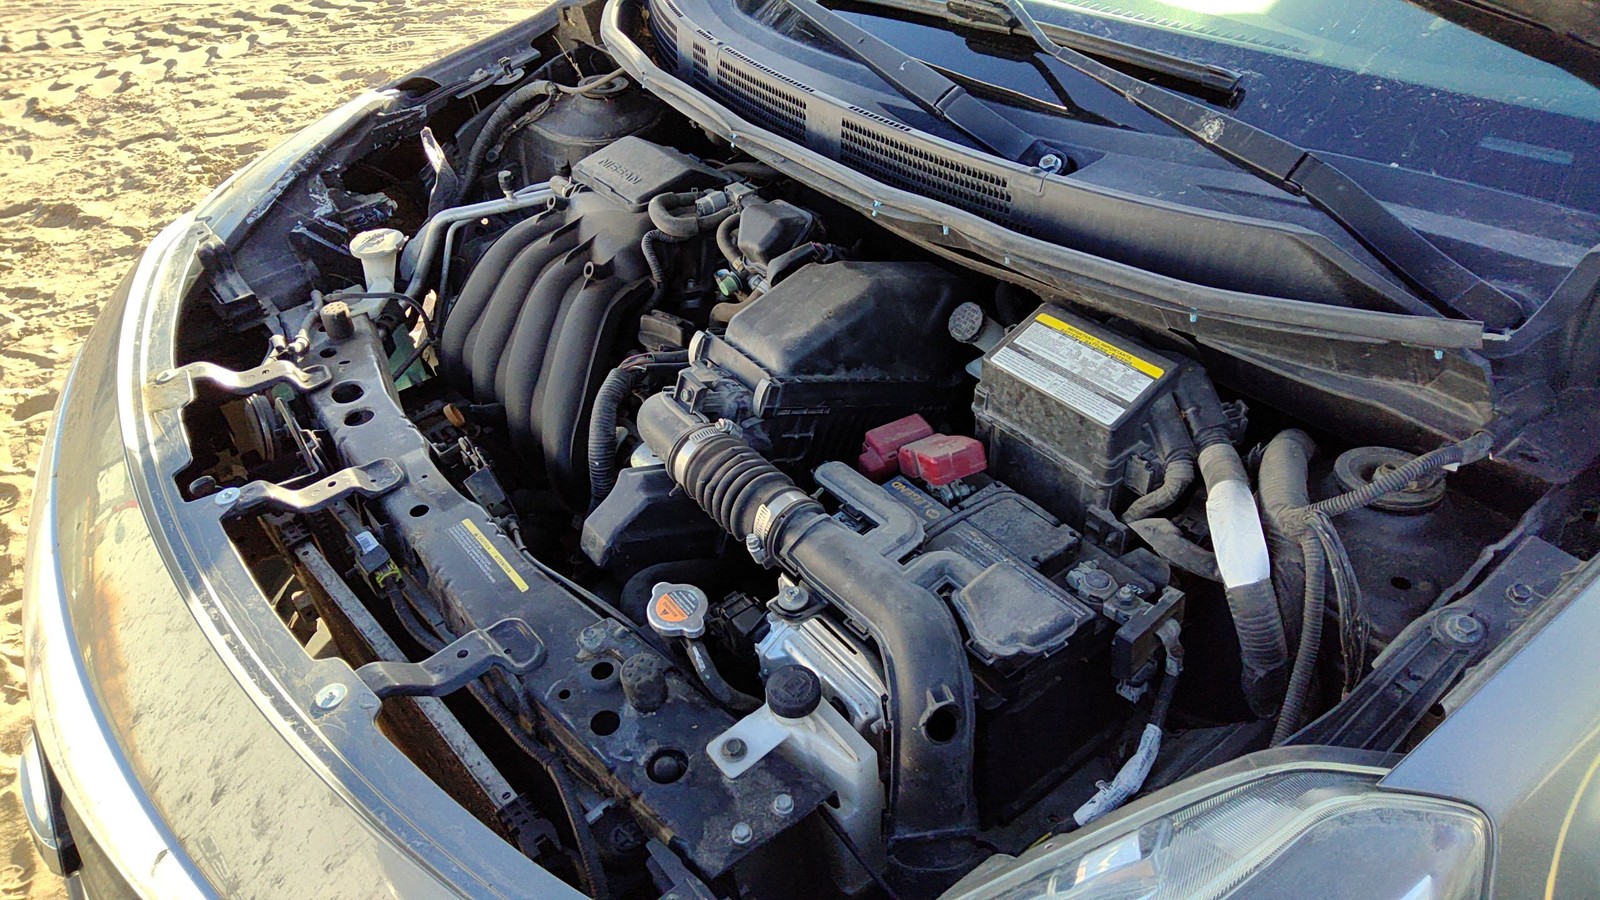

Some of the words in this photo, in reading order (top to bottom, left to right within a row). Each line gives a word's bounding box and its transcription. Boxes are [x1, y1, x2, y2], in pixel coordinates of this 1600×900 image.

[598, 158, 642, 184] NISSAN
[1066, 326, 1094, 341] IMPORTANT
[1100, 342, 1132, 360] IMPORTANTE
[891, 481, 933, 508] LEGEND
[476, 534, 491, 550] CAUTION
[493, 554, 511, 573] ATTENTION
